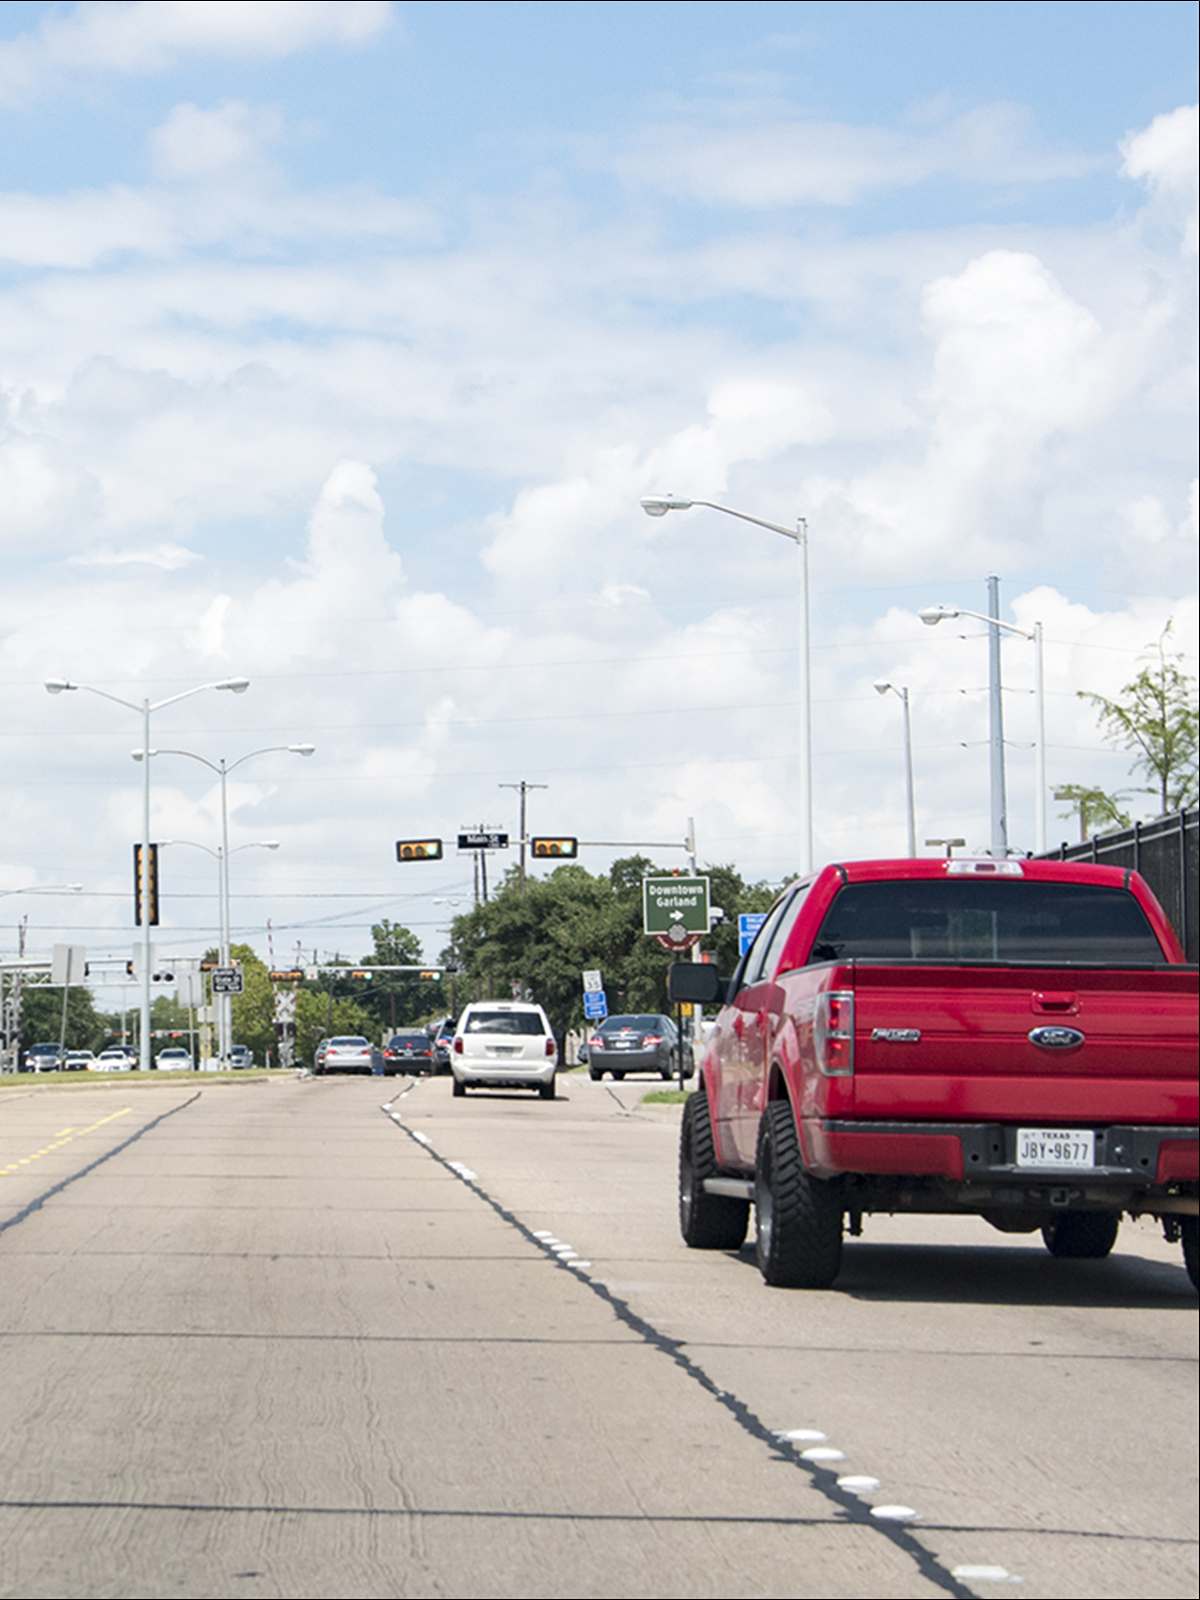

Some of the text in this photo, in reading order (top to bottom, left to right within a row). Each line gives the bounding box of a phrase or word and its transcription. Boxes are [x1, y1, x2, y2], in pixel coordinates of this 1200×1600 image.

[649, 885, 704, 895] Downtown
[656, 896, 698, 907] Garland
[1040, 1030, 1073, 1044] Ford
